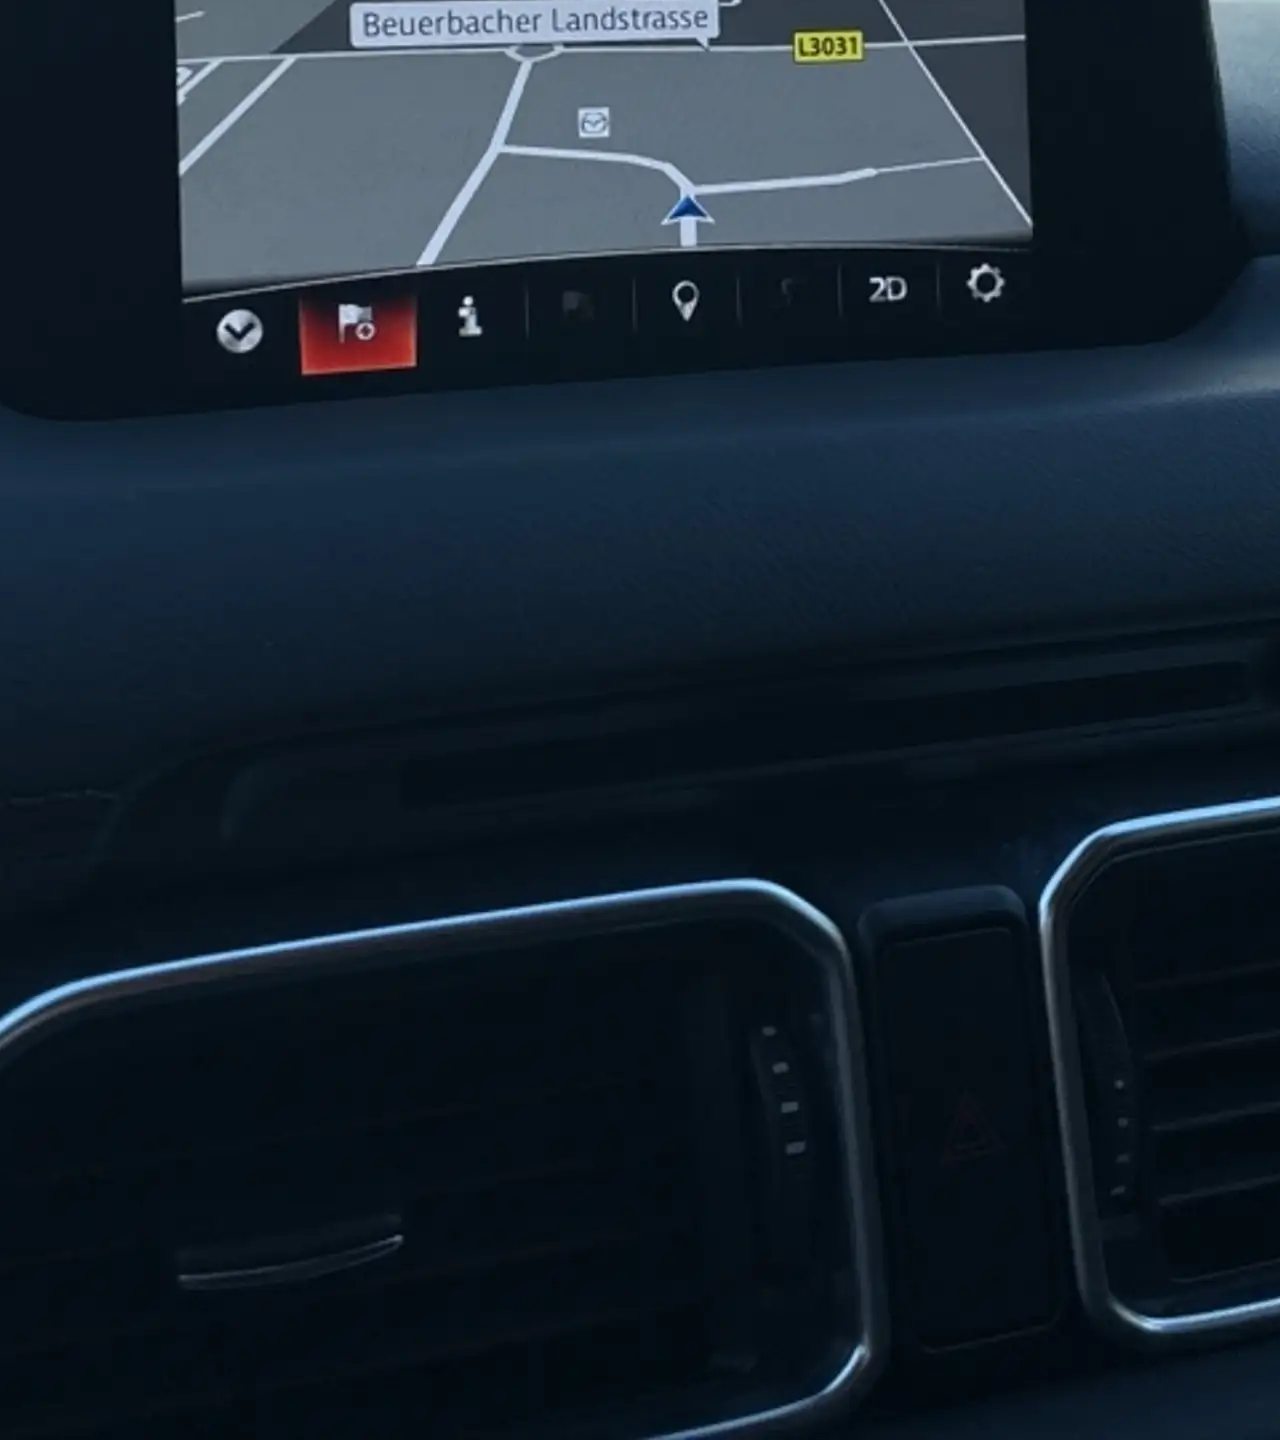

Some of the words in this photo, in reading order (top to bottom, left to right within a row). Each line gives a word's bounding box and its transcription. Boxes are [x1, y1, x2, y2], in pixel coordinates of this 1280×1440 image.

[363, 10, 543, 37] Beuerbacher
[551, 7, 709, 33] Landstrasse
[798, 36, 859, 57] L3031
[869, 276, 908, 302] 2D
